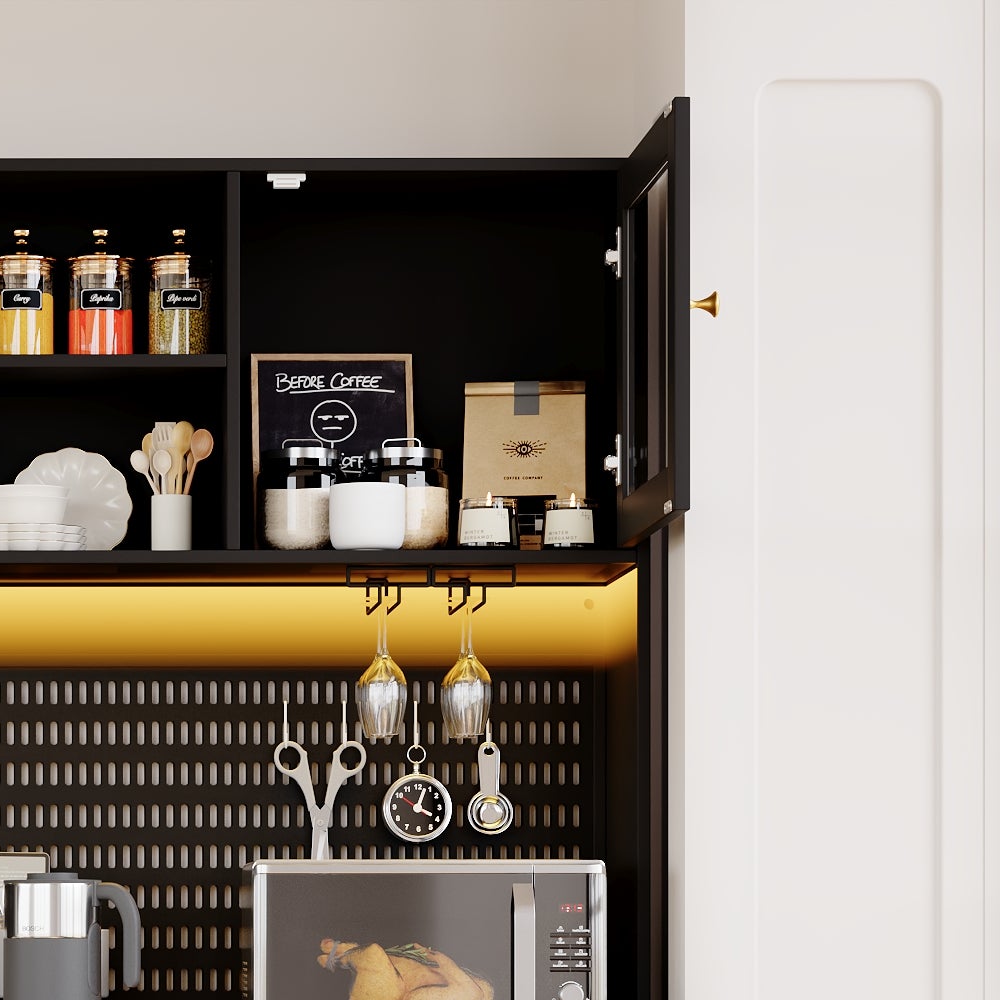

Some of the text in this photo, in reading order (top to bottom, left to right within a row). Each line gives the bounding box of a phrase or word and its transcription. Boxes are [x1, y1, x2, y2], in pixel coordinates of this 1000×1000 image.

[13, 293, 31, 304] Curry
[88, 293, 115, 304] Paprika
[275, 372, 383, 392] BEFORE COFFEE
